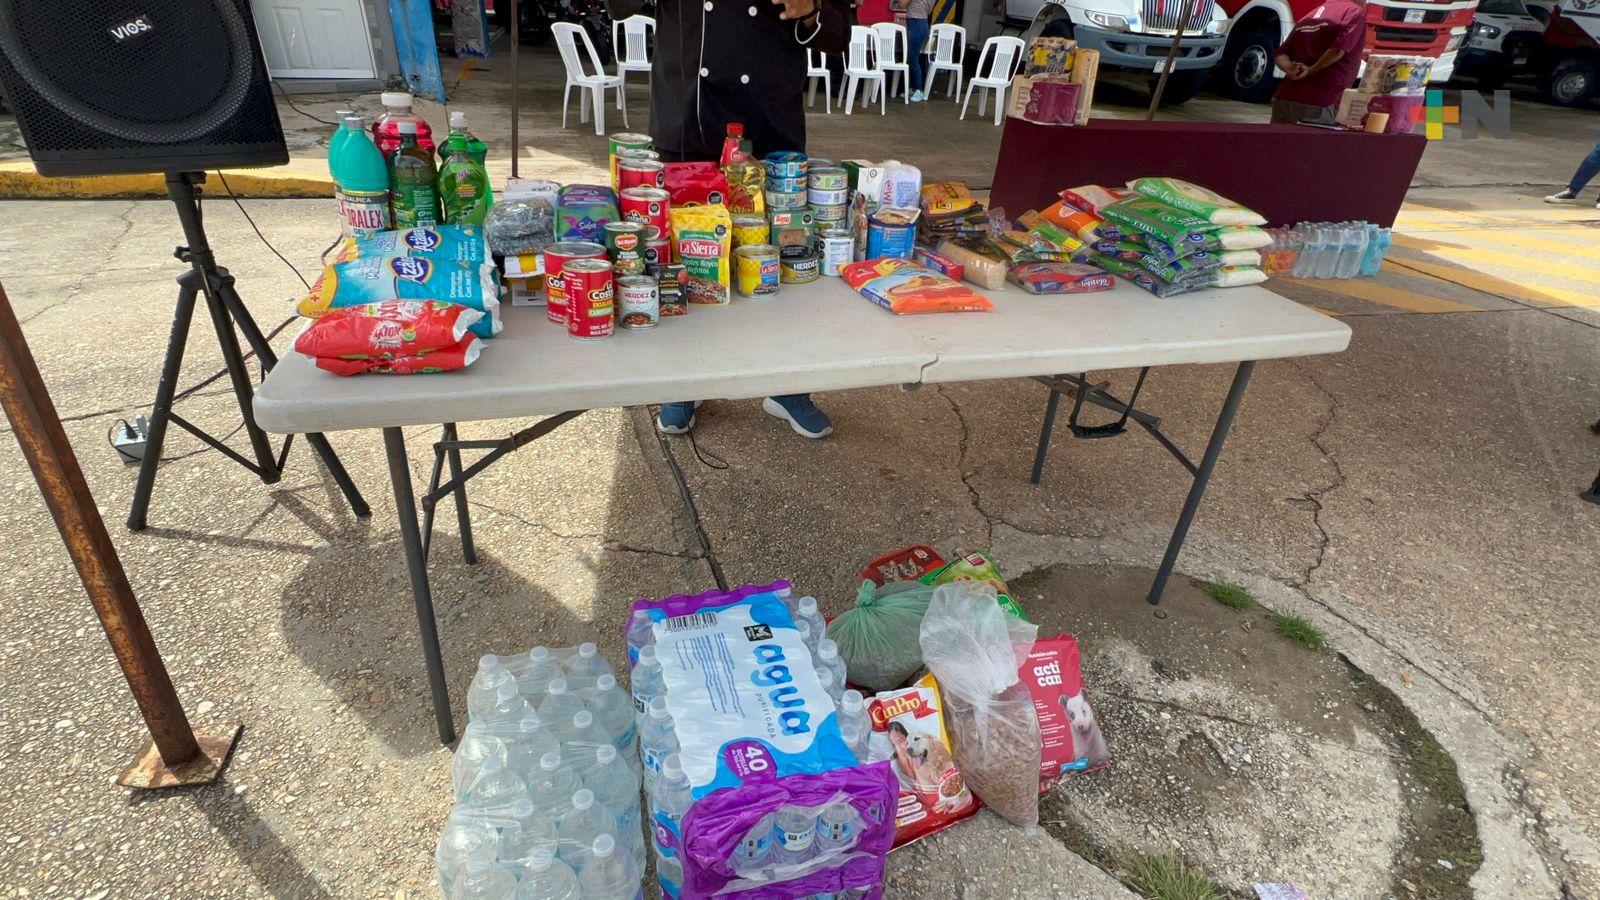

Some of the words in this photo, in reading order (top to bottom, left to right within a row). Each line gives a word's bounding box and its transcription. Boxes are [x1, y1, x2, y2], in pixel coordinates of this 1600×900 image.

[111, 19, 150, 40] VIOS
[680, 242, 689, 253] La
[690, 241, 719, 256] Sierra
[1033, 660, 1060, 677] acti
[751, 644, 810, 736] agua
[1037, 674, 1062, 687] can
[755, 692, 776, 739] PURIFICADA
[745, 746, 768, 771] 40
